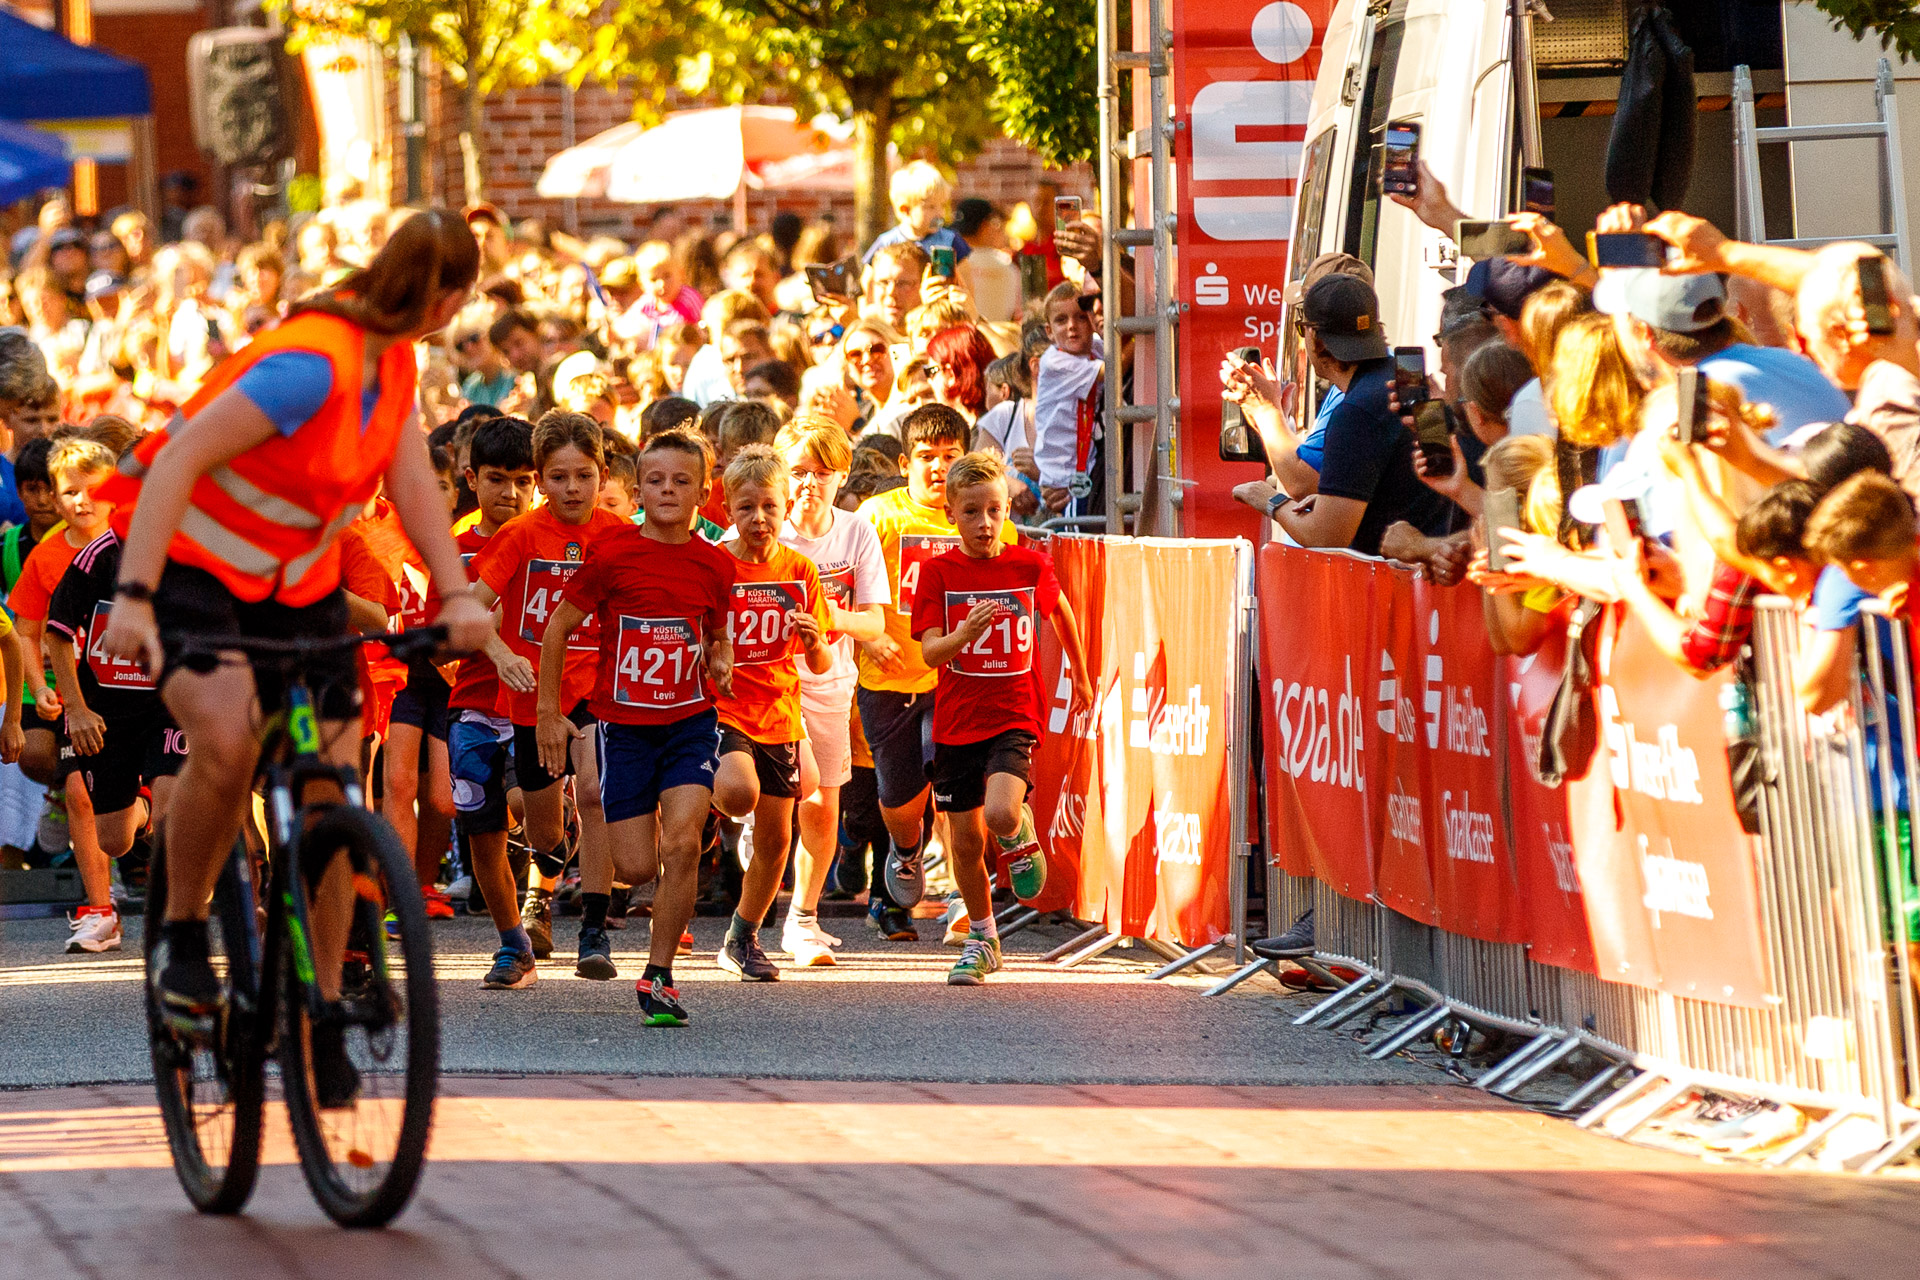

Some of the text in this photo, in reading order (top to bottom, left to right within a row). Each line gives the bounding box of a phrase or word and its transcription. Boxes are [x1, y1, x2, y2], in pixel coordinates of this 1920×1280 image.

[747, 588, 777, 597] KÜSTEN
[747, 595, 786, 604] MARATHON
[653, 625, 684, 634] KÜSTEN
[653, 632, 691, 641] MARATHON
[747, 649, 769, 659] Joost
[619, 643, 701, 686] 4217
[982, 660, 1008, 669] Julius
[653, 690, 676, 700] Levis
